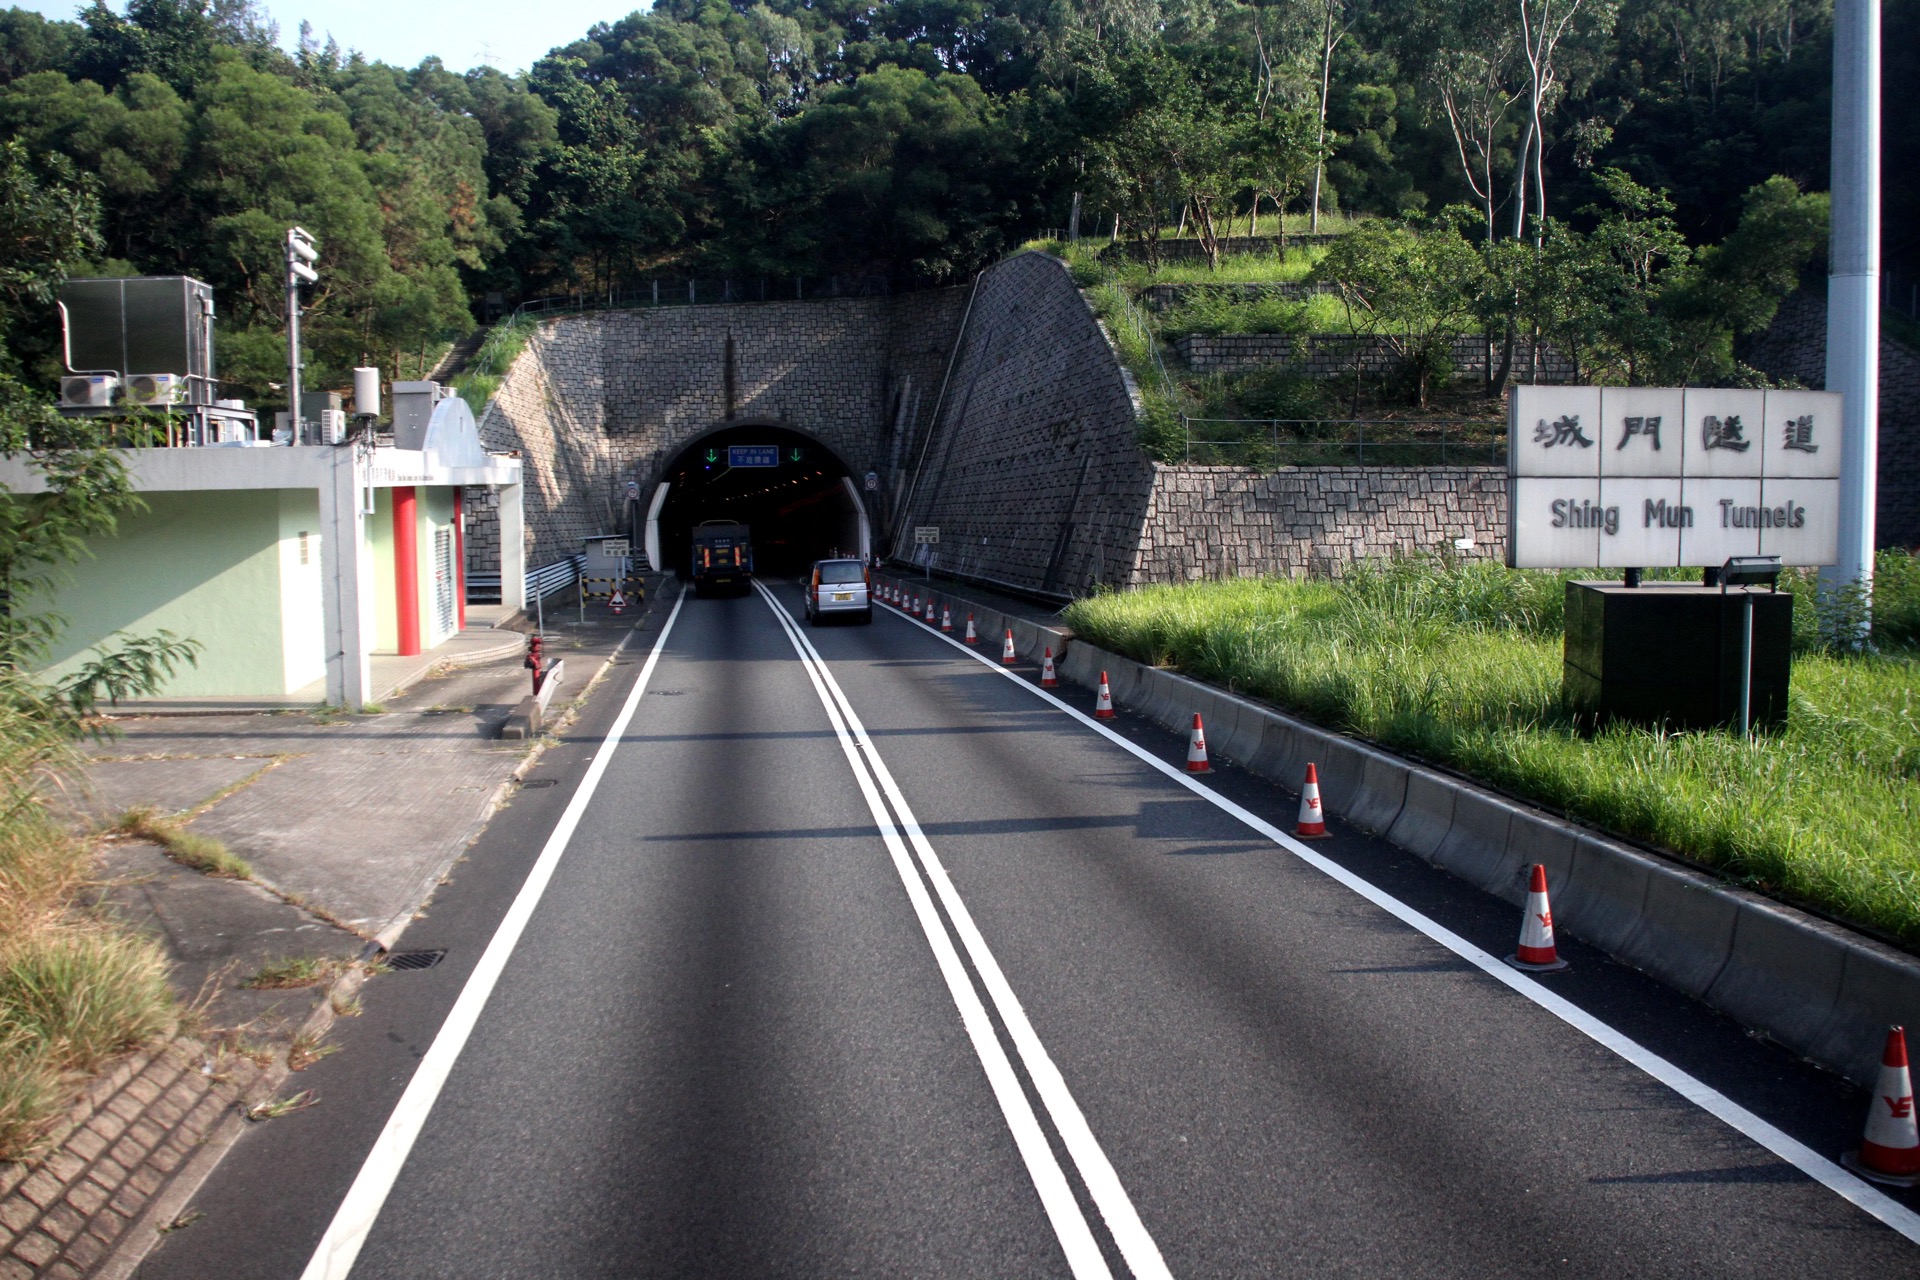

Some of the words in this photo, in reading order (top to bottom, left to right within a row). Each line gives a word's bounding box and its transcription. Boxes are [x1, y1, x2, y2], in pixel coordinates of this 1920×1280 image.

[1533, 414, 1819, 453] 城門隧道
[1549, 498, 1620, 536] Shing
[1644, 498, 1694, 529] Mun
[1719, 498, 1805, 529] Tunnels
